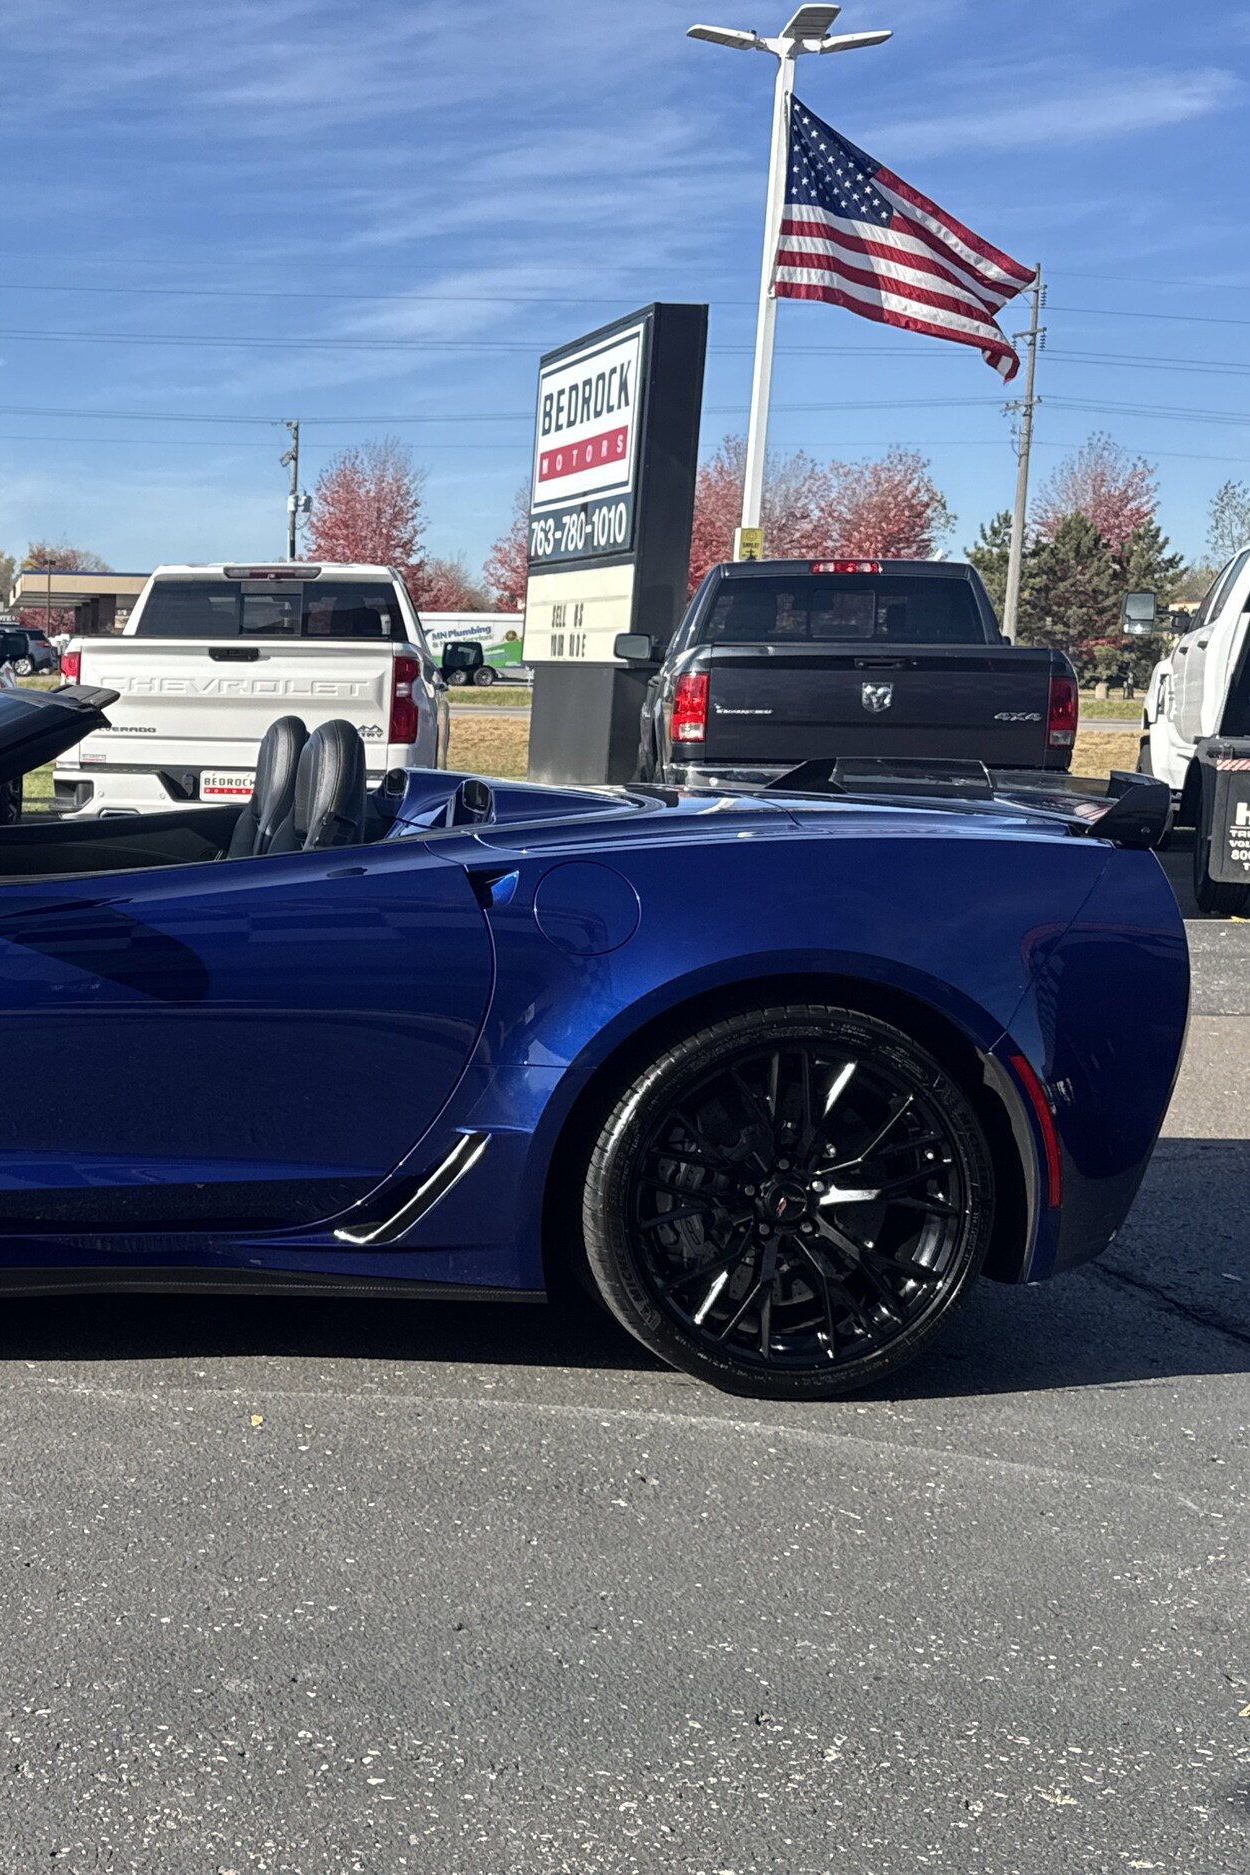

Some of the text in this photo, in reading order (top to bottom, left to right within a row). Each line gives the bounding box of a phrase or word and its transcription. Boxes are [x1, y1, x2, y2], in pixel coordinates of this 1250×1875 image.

[542, 360, 631, 437] BEDROCK
[542, 435, 623, 475] MOTORS
[531, 502, 626, 556] 763-780-1010
[431, 626, 492, 641] MN Plumbing
[101, 676, 370, 696] CHEVROLET
